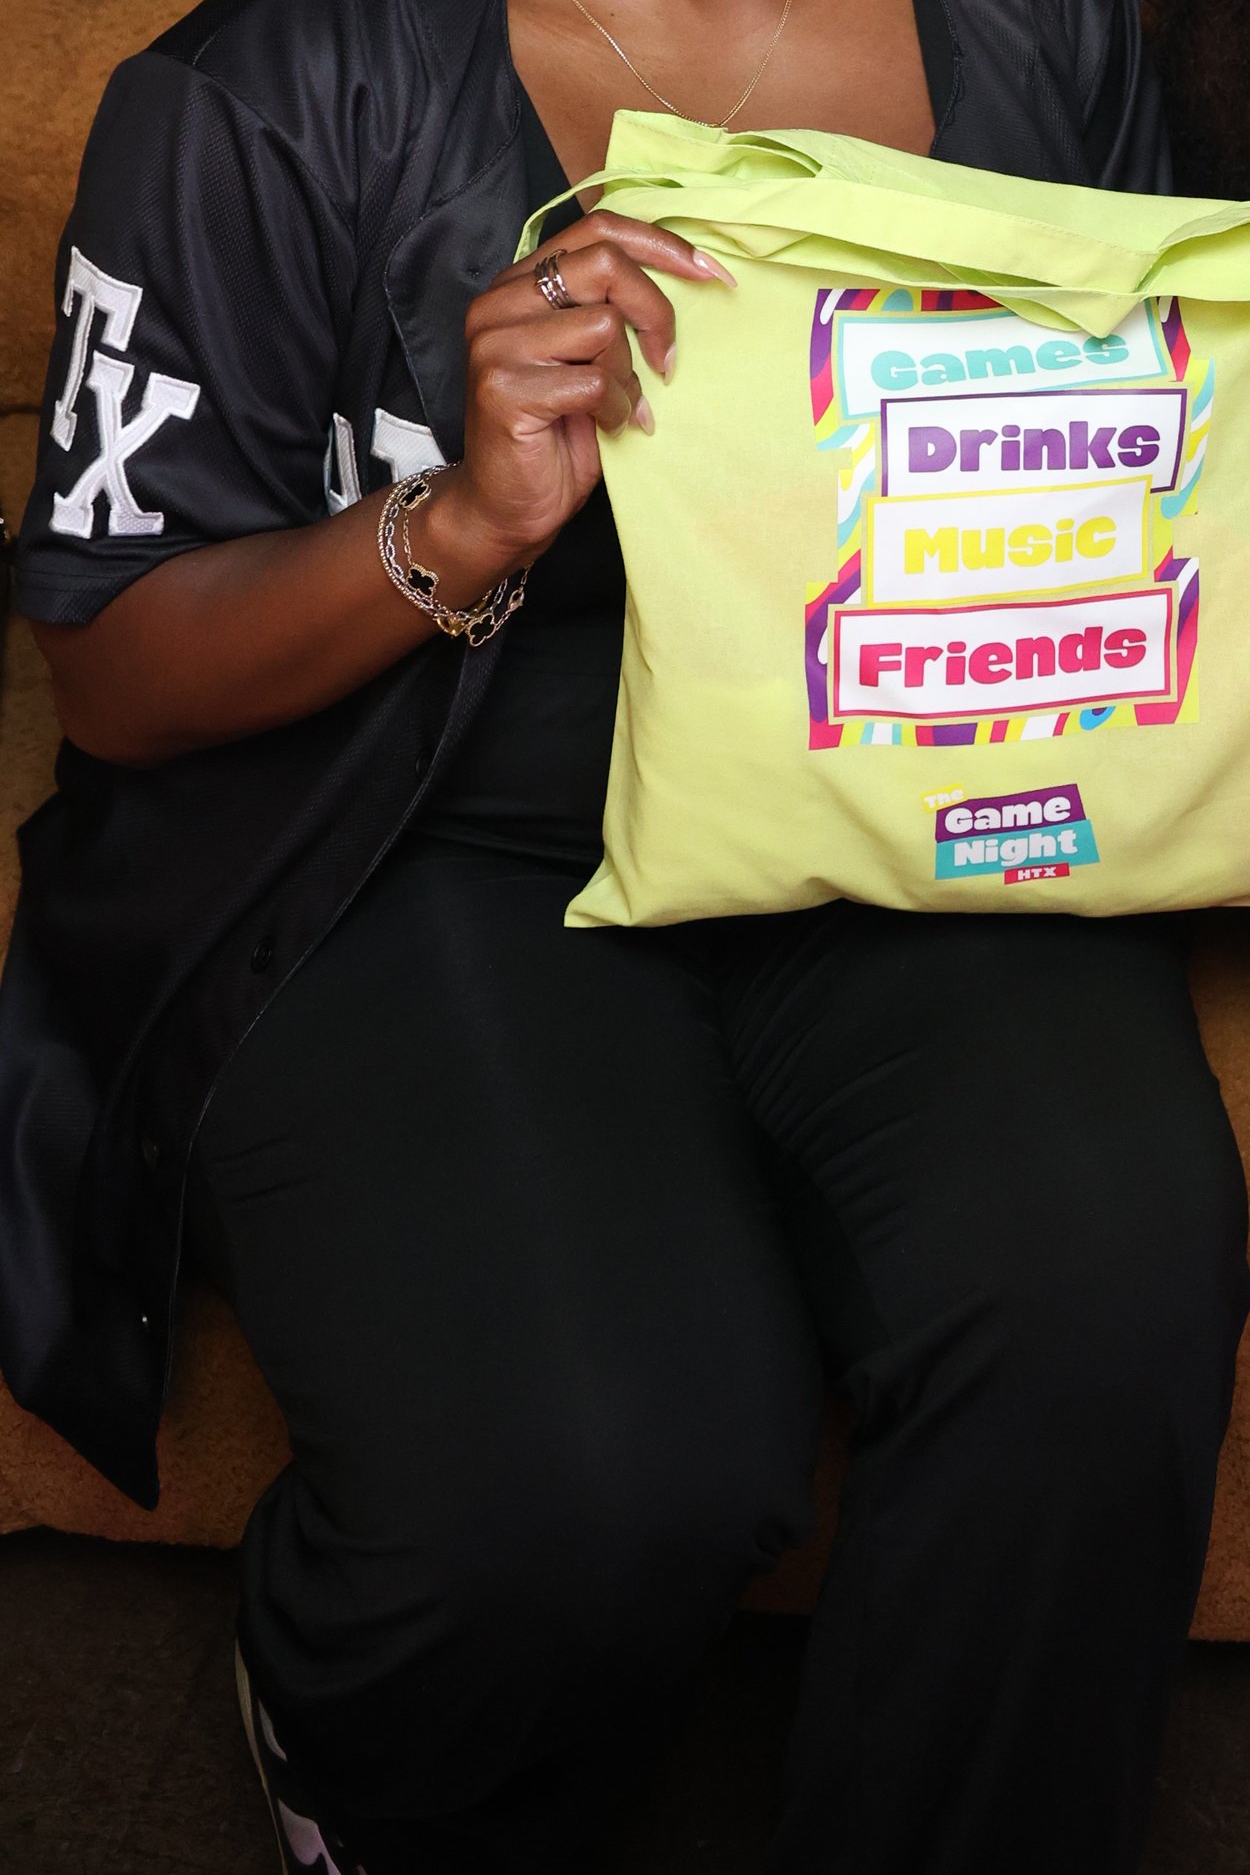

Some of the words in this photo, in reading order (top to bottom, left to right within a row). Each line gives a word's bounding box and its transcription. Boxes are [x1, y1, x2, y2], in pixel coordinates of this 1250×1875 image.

[871, 334, 1130, 391] Games
[908, 421, 1161, 473] Drinks
[903, 516, 1117, 574] Music
[858, 626, 1147, 688] Friends
[924, 788, 964, 808] The
[945, 796, 1071, 833] Game
[954, 829, 1078, 867] Night
[1018, 867, 1056, 880] HTX
